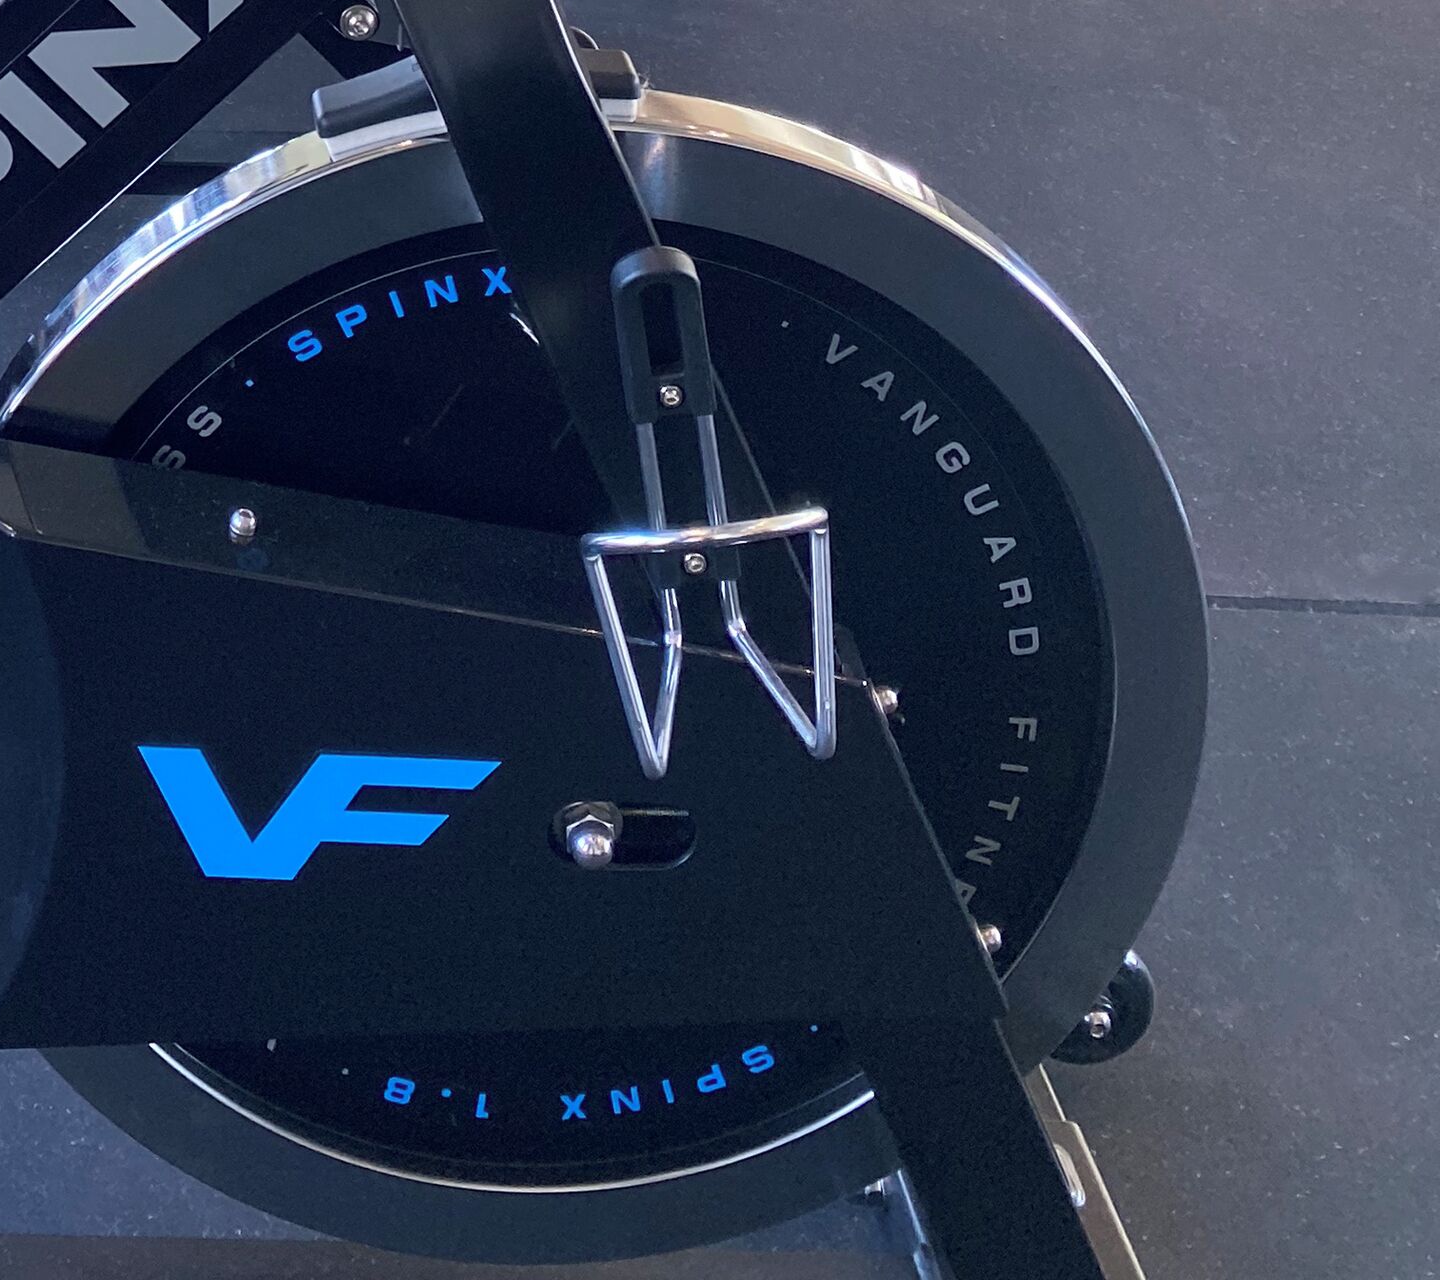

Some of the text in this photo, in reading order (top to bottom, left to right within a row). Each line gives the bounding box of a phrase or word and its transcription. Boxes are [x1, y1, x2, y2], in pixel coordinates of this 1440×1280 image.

[287, 266, 513, 363] SPINX
[825, 333, 1040, 656] VANGUARD
[138, 745, 501, 881] VF
[382, 1043, 776, 1121] SPINX 1.8
